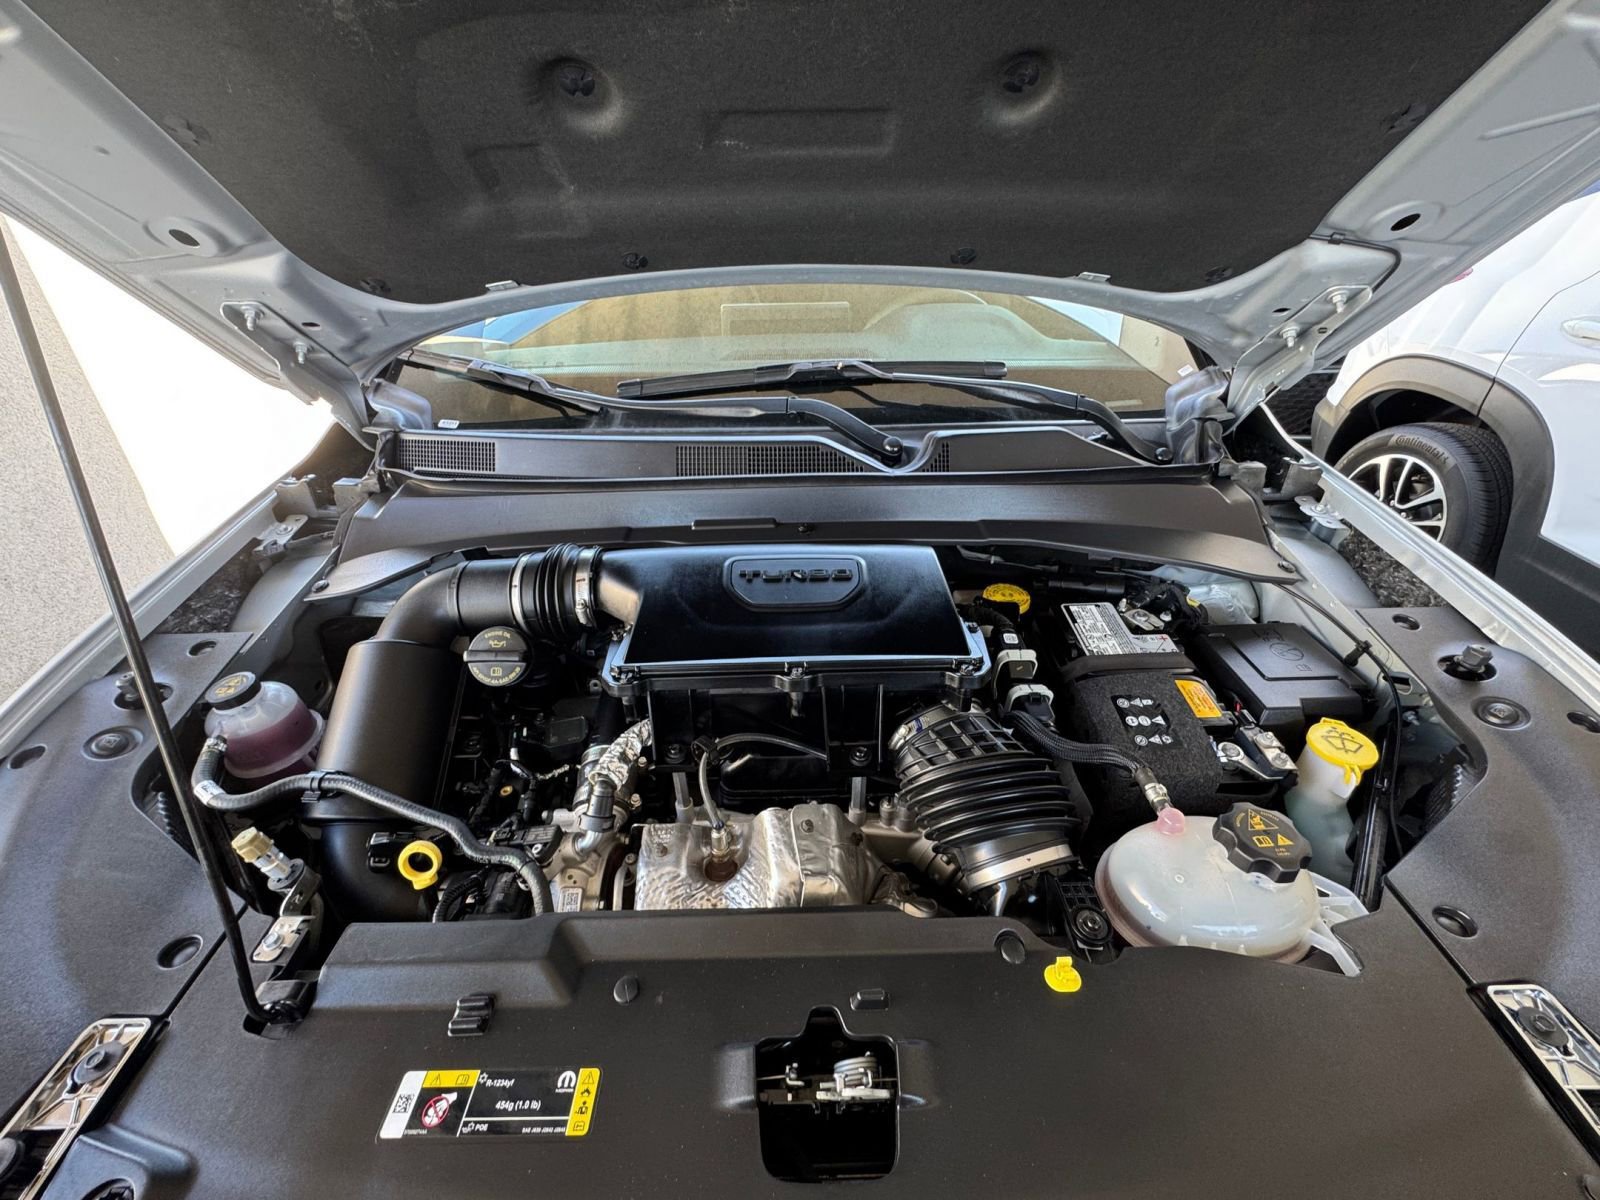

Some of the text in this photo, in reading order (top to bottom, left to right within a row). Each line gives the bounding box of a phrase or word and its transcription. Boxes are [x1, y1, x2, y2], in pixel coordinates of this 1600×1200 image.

[1395, 435, 1445, 460] Continental
[739, 568, 853, 583] TURBO
[486, 1079, 515, 1088] R-1234yf
[495, 1100, 542, 1111] 454g (1.0 lb)
